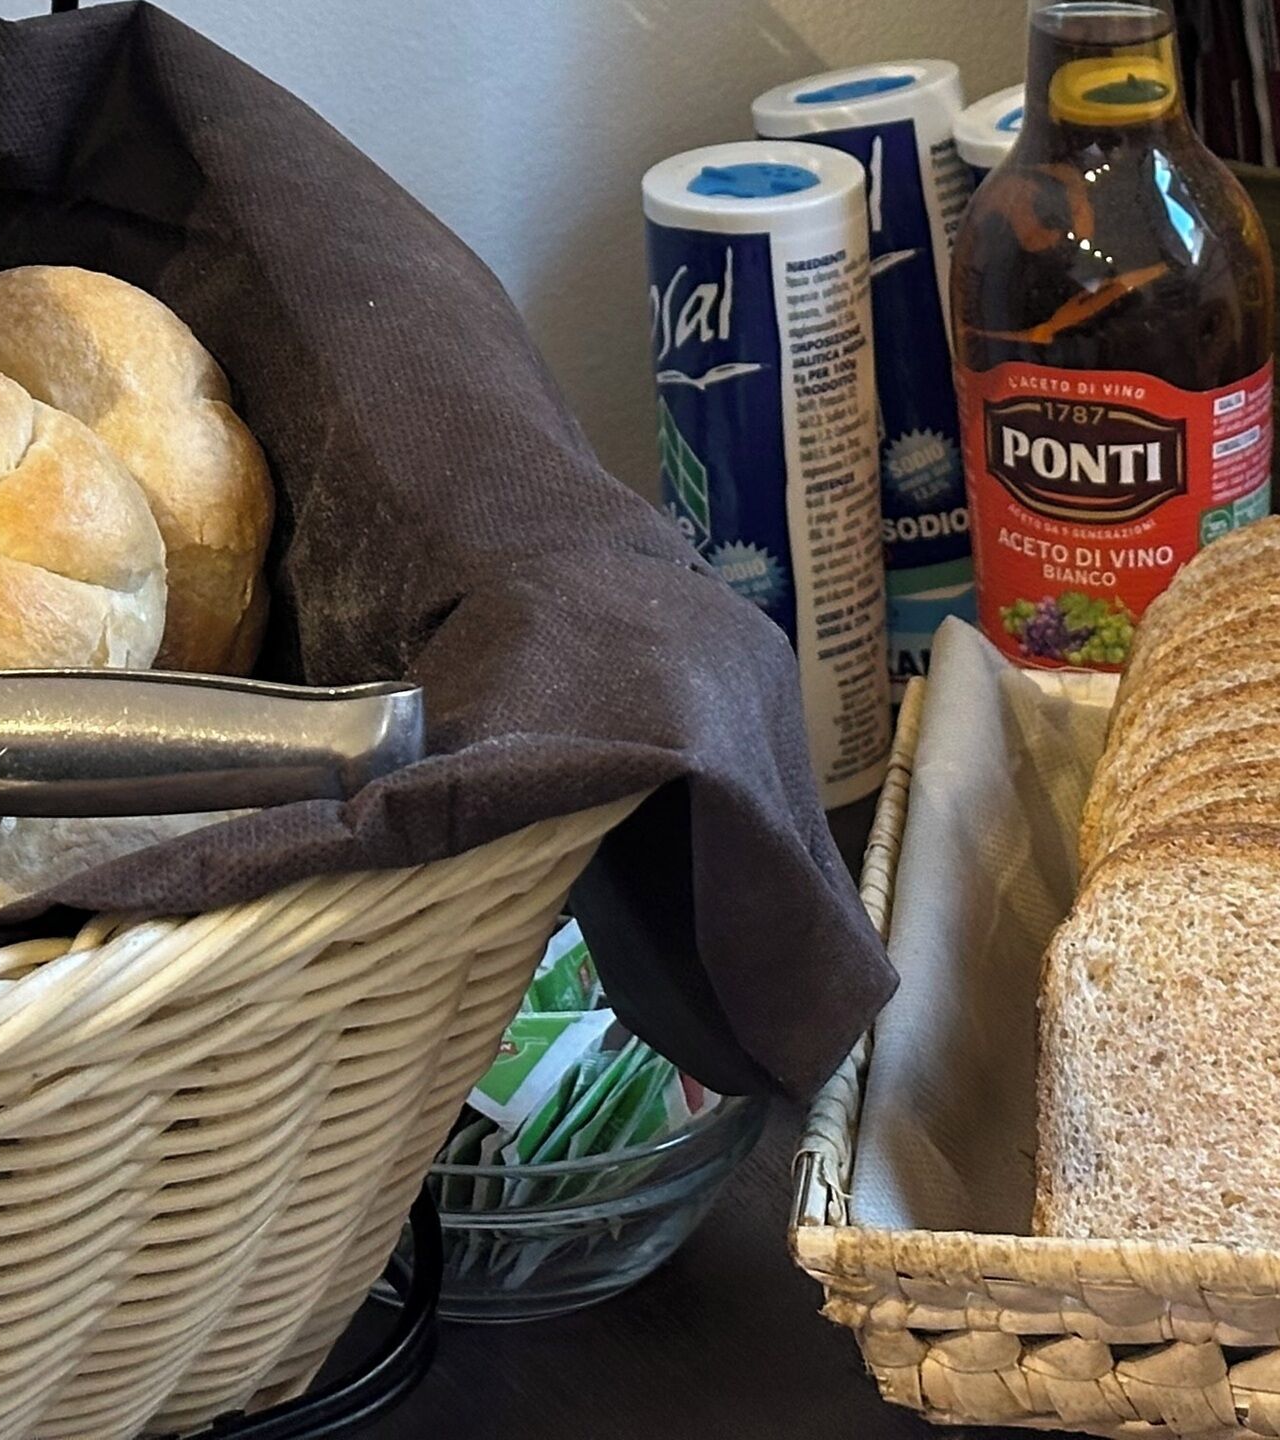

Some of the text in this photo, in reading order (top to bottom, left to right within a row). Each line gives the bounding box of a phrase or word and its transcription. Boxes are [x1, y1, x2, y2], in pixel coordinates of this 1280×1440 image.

[1078, 383, 1095, 395] DI
[1102, 384, 1146, 400] VINO
[1044, 401, 1105, 426] 1787
[1002, 425, 1162, 485] PONTI
[882, 508, 970, 543] SODIO
[998, 526, 1174, 570] ACETO DI VINO
[1042, 563, 1117, 588] BIANCO
